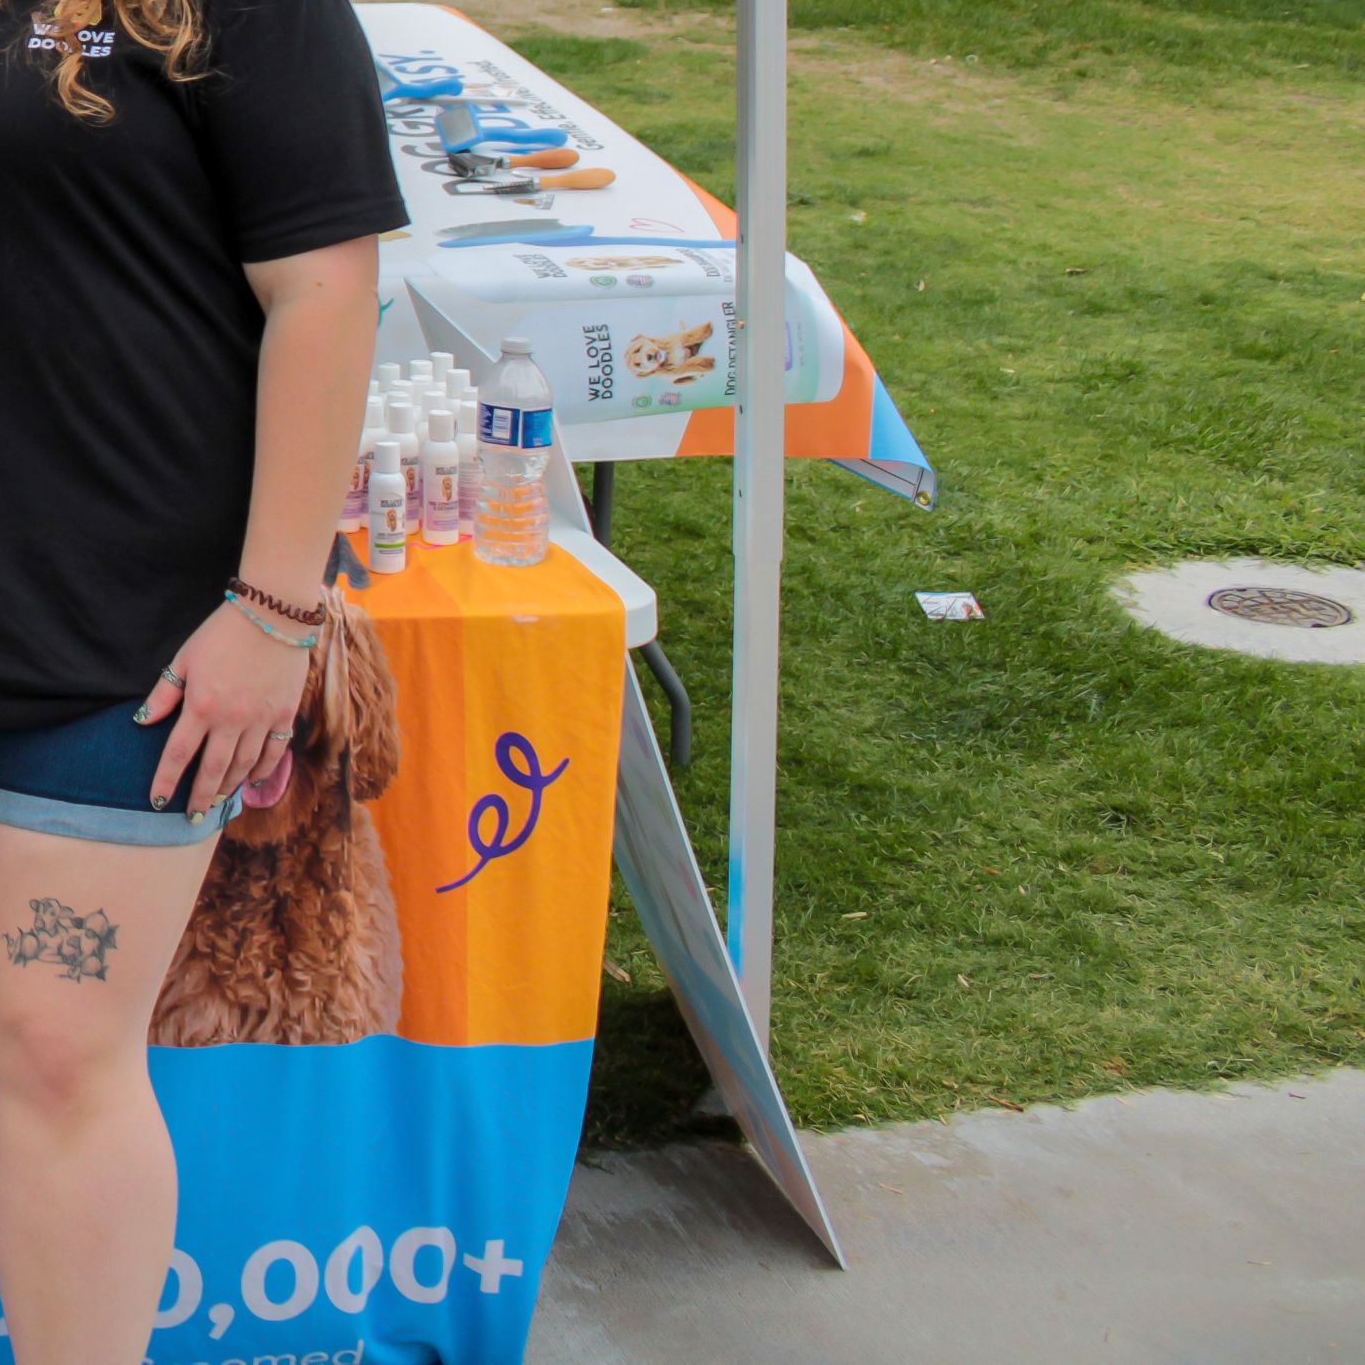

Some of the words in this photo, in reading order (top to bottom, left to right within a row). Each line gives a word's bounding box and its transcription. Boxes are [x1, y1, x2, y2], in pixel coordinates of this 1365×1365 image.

[582, 324, 600, 369] LOVE
[596, 323, 614, 400] DOODLES
[588, 375, 601, 402] WE
